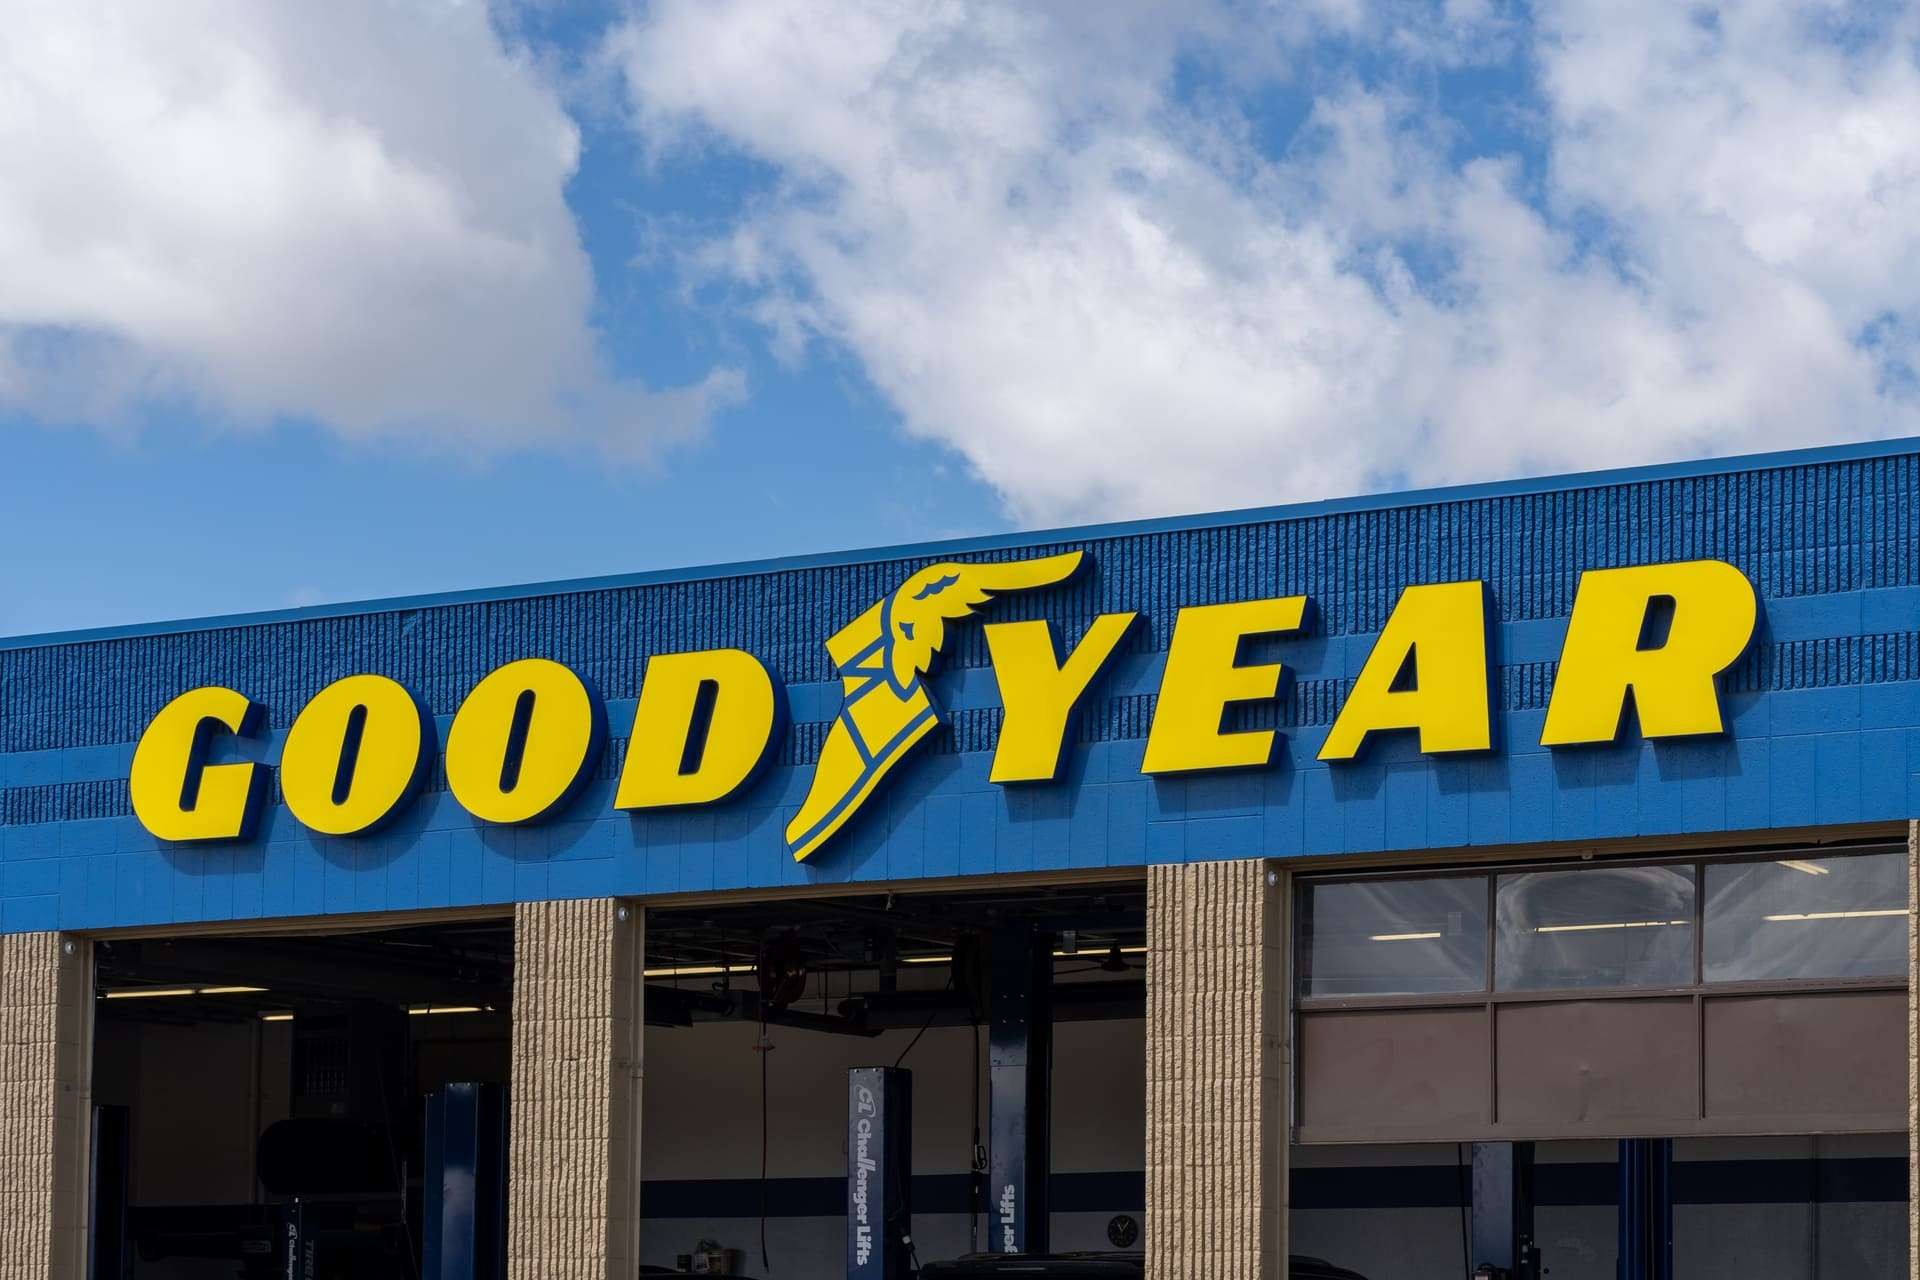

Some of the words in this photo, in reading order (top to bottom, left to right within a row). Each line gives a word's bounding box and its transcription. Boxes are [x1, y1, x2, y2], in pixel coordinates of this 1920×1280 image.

[853, 1119, 876, 1224] Challenger
[1000, 1184, 1016, 1224] Lifts
[856, 1225, 872, 1266] Lifts
